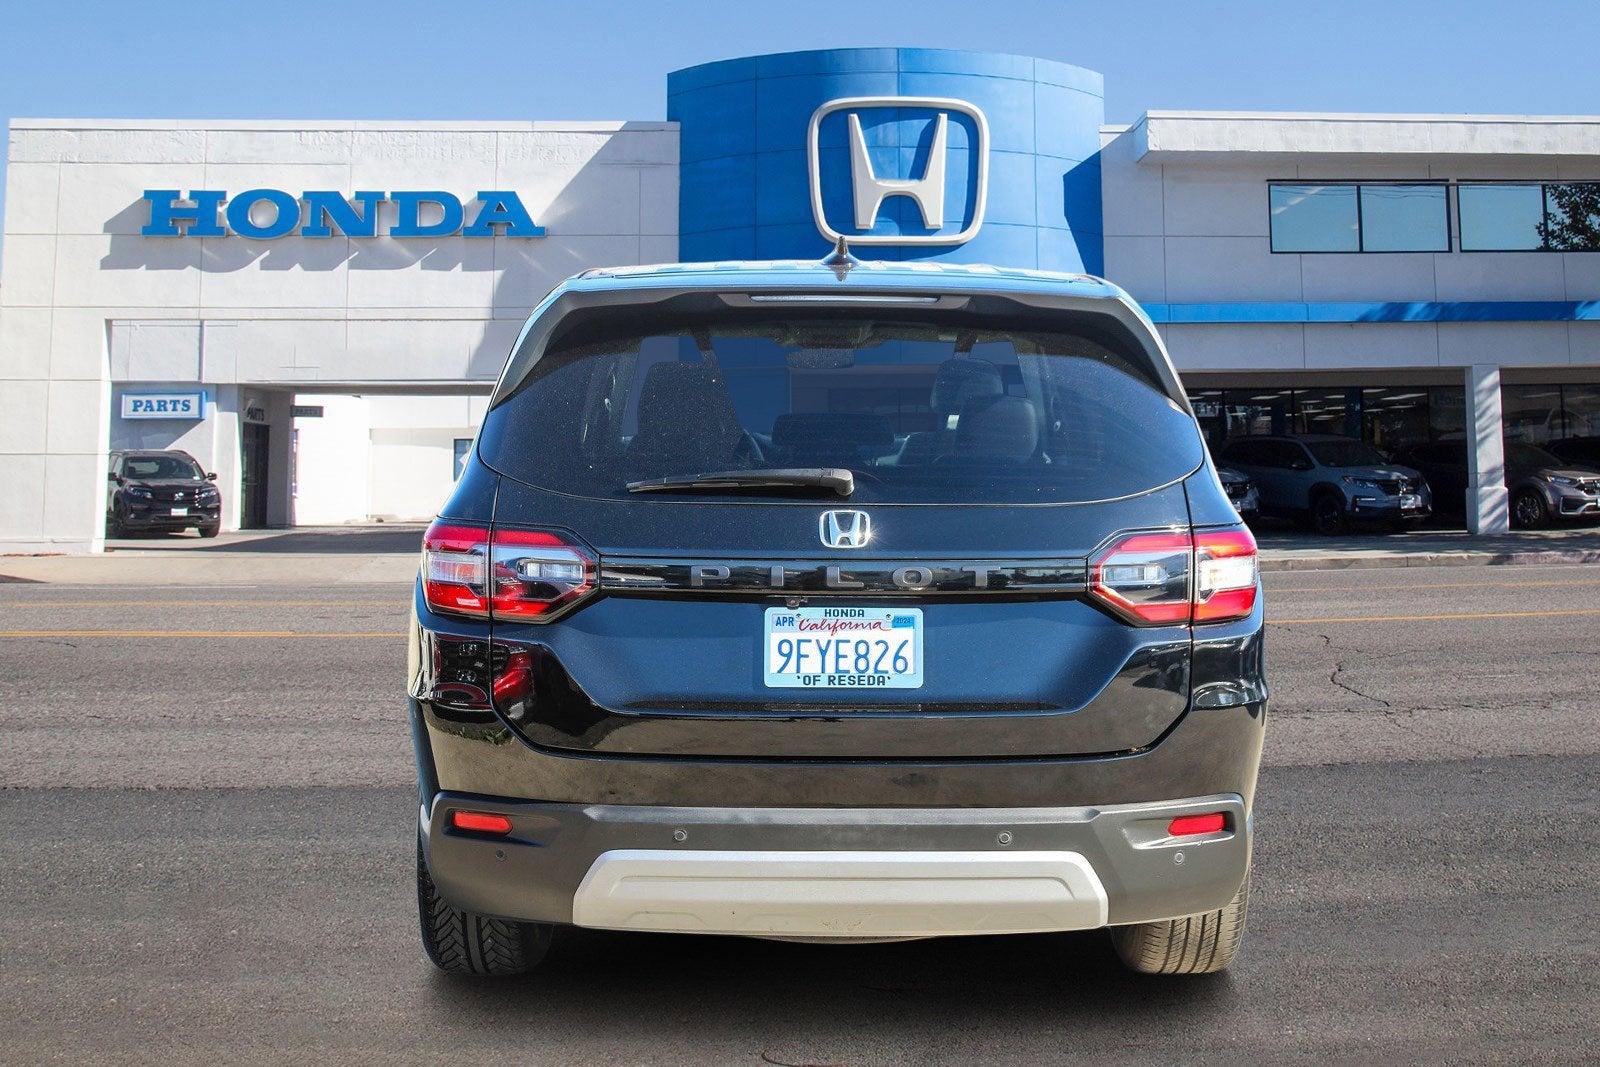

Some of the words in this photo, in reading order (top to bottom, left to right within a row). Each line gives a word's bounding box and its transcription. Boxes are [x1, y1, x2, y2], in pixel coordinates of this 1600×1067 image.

[142, 188, 547, 240] HONDA
[132, 399, 191, 413] PARTS
[690, 565, 1001, 591] PILOT
[824, 608, 865, 618] HONDA
[775, 616, 795, 627] APR
[798, 618, 892, 637] California
[777, 638, 909, 674] 9FYE826
[803, 675, 821, 686] OF
[828, 675, 886, 686] RESEDA
